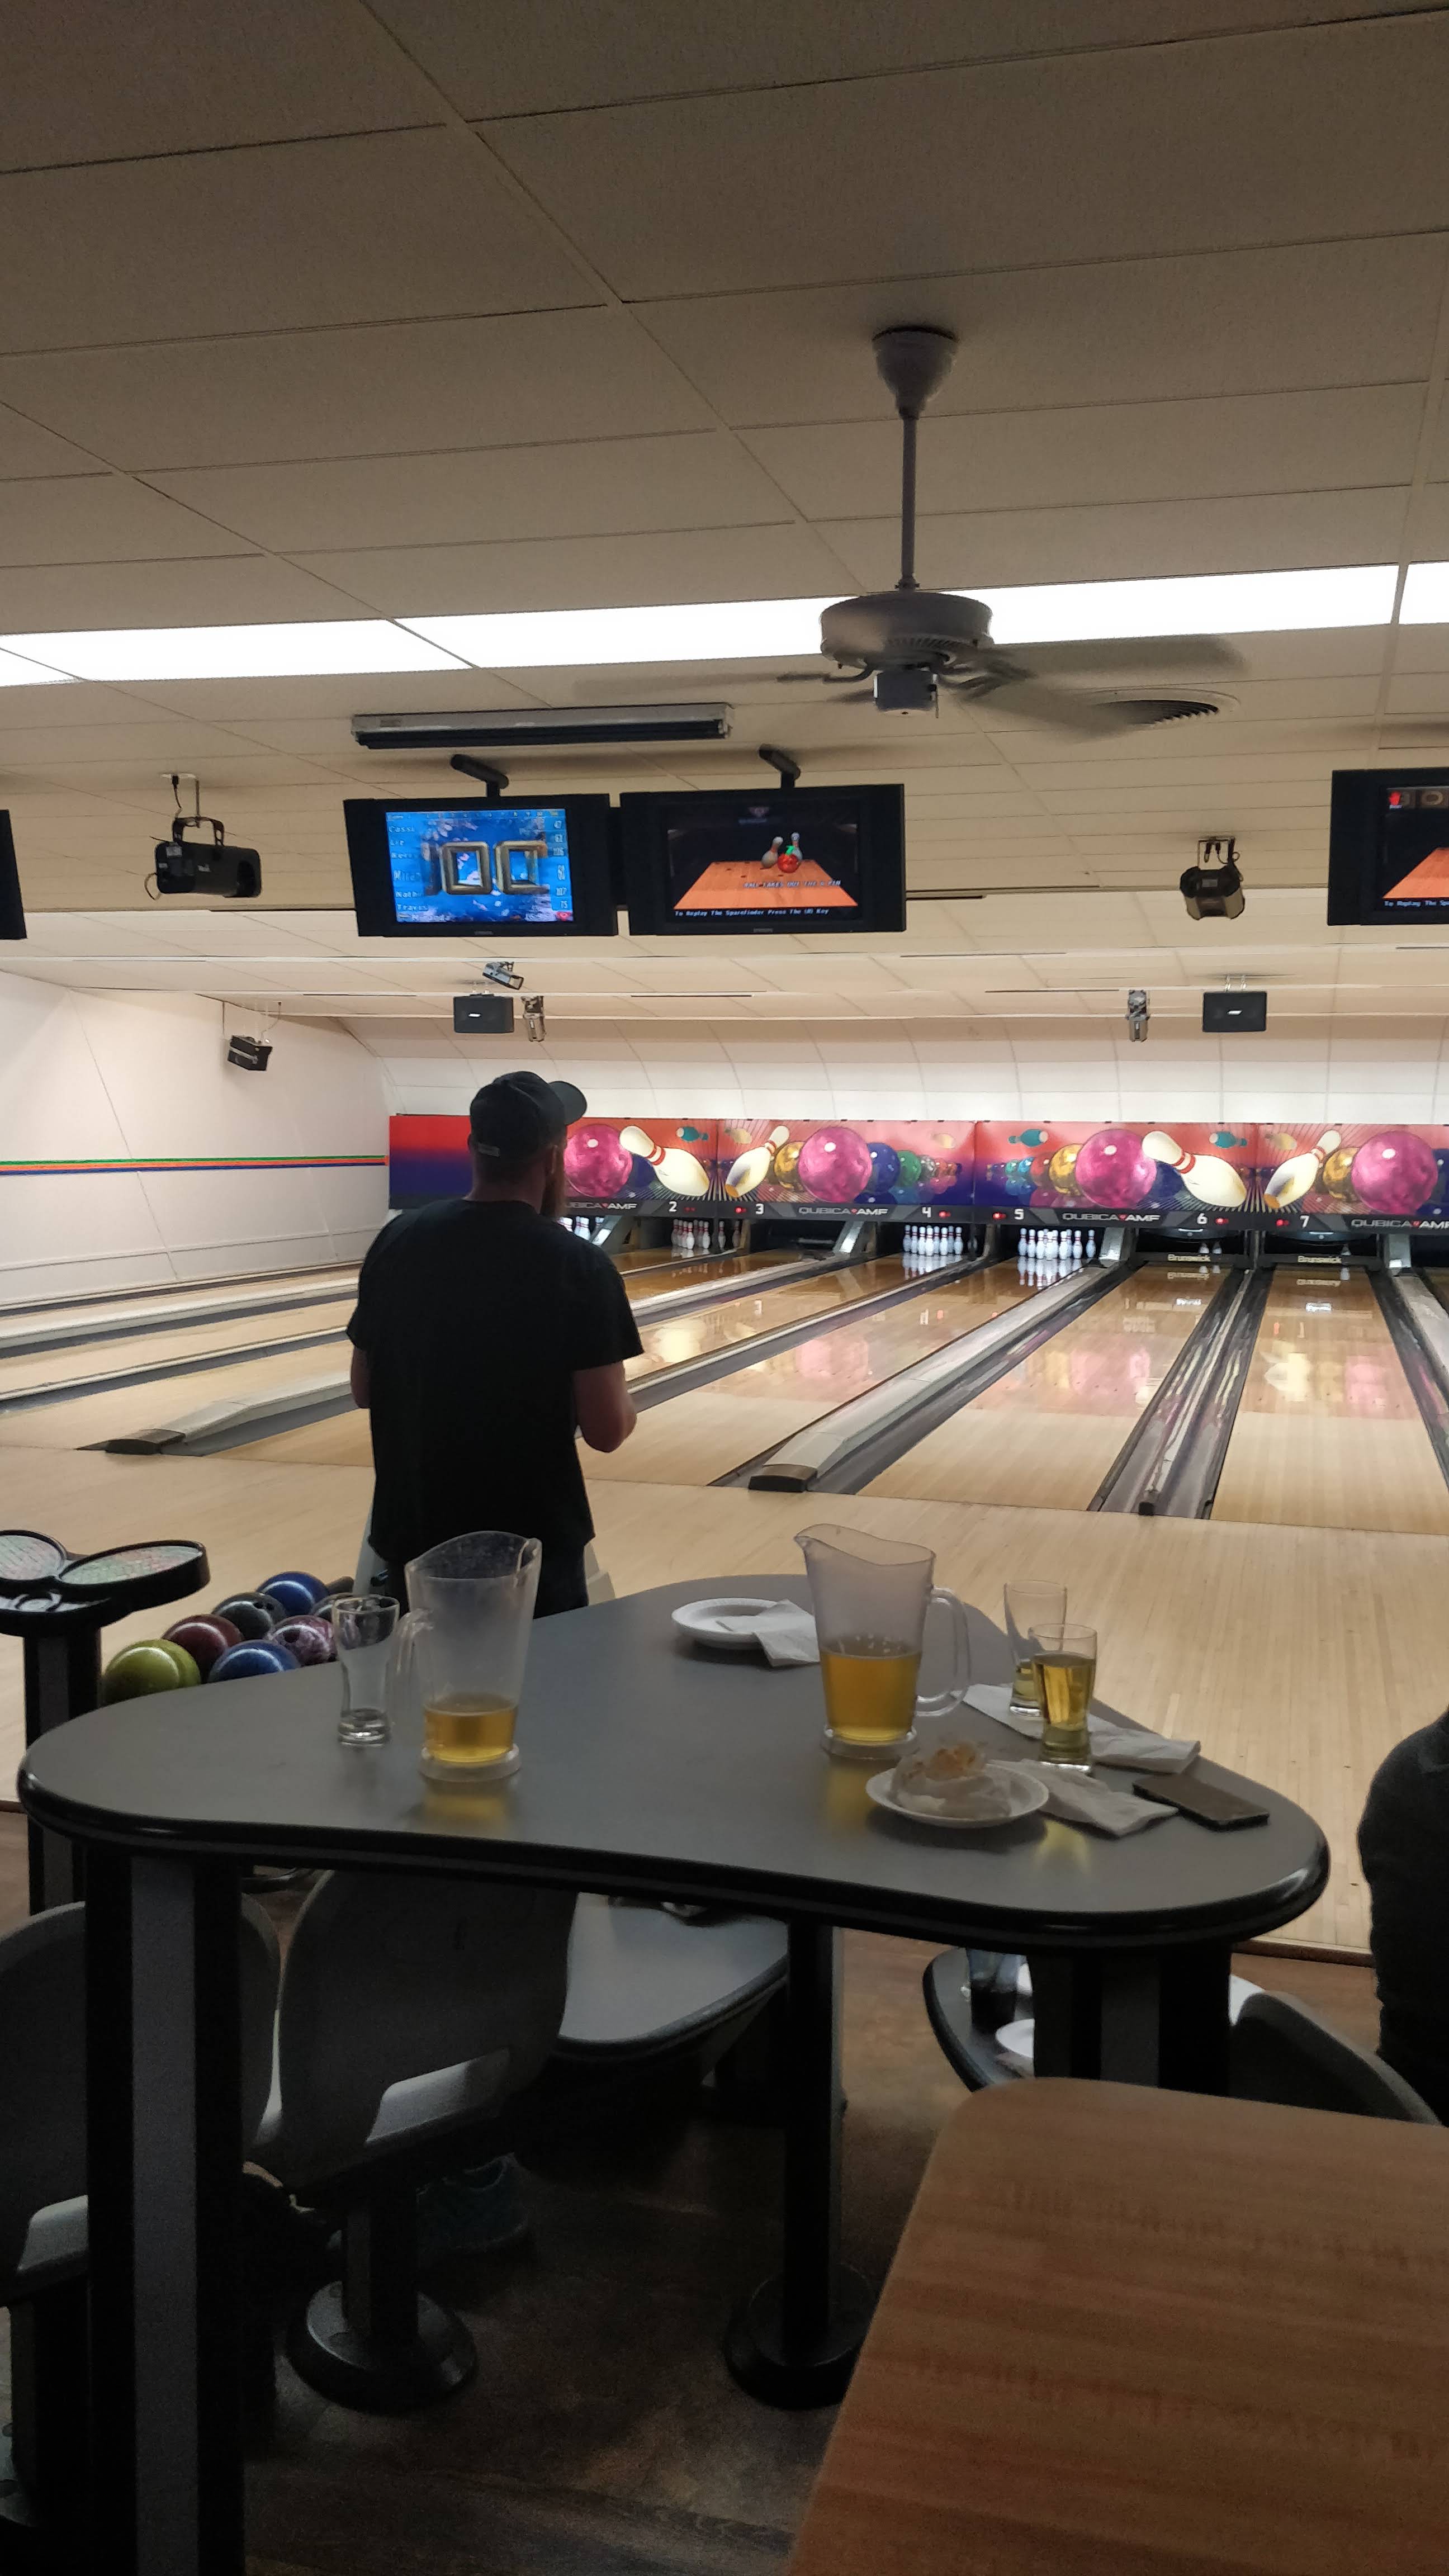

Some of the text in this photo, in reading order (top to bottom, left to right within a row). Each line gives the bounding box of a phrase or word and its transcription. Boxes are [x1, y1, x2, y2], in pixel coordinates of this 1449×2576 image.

[668, 1201, 677, 1212] 2
[756, 1203, 764, 1214] 3
[922, 1206, 931, 1218] 4
[1014, 1208, 1024, 1220] 5
[1197, 1213, 1208, 1225] 6
[1300, 1215, 1310, 1228] 7
